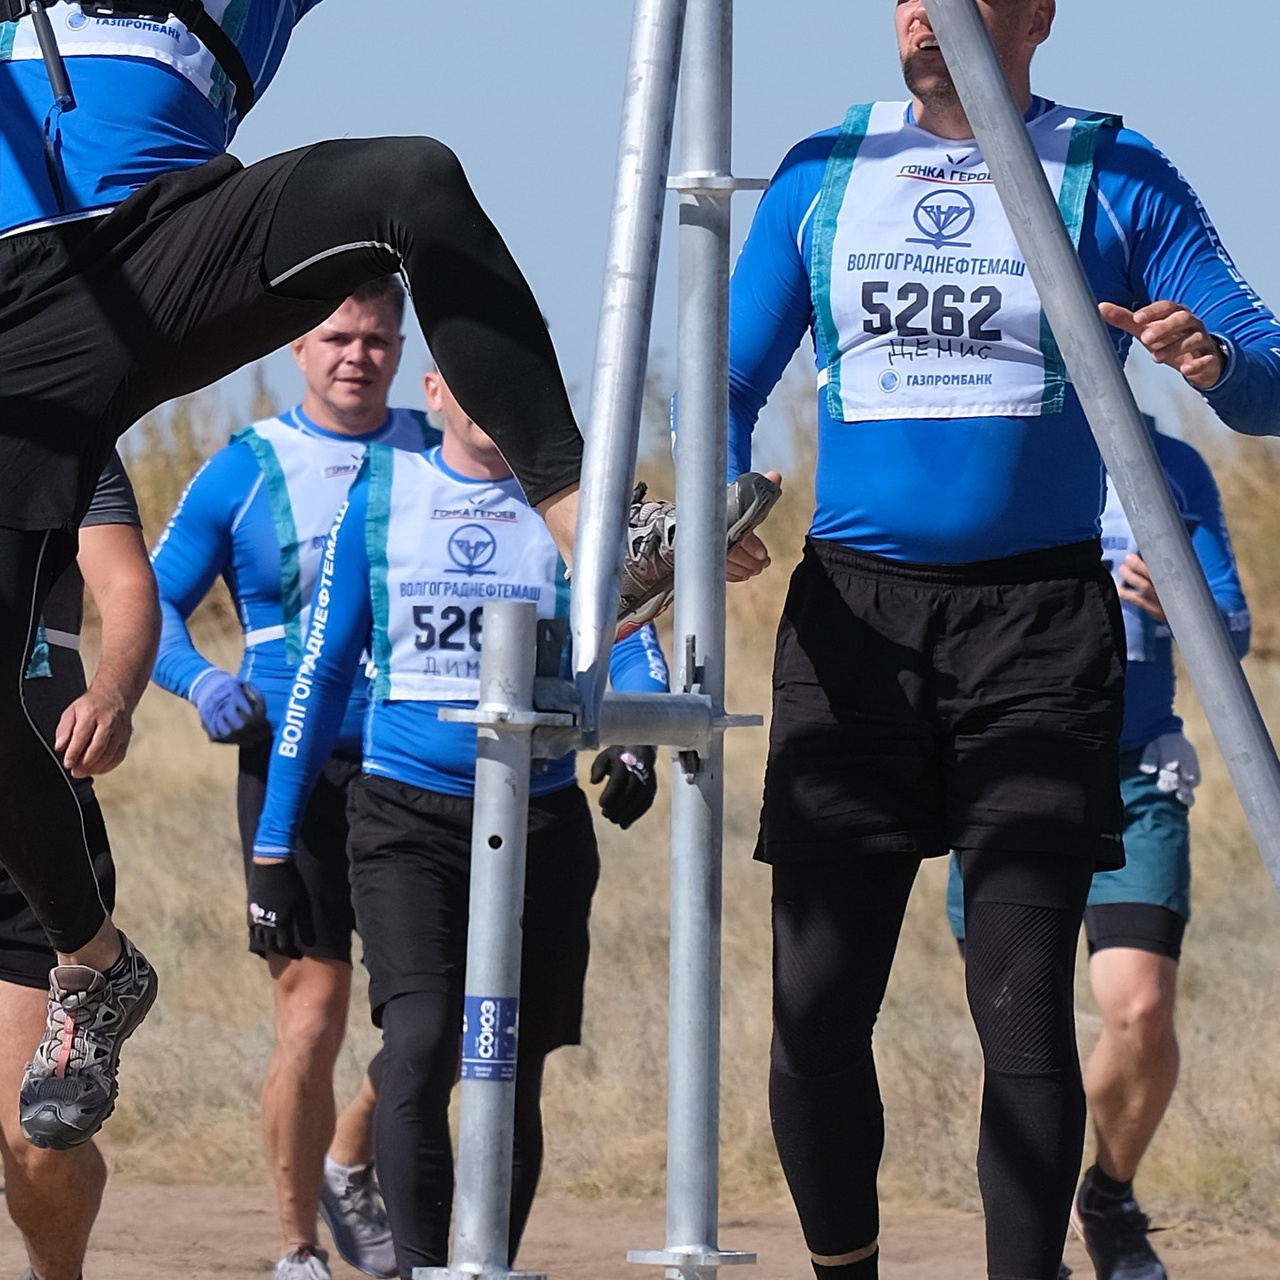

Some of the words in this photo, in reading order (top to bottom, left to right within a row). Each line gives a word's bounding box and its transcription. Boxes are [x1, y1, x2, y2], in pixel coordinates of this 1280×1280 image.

[95, 17, 182, 44] ГАЗПРОМБАНК
[899, 163, 946, 181] ГОНКА
[846, 252, 1026, 278] ВОЛГОГРАДНЕФТЕМАШ
[861, 281, 1003, 342] 5262
[887, 338, 993, 366] ДЕНИС
[906, 373, 993, 387] ГАЗПРОМБАНК
[399, 581, 542, 602] ВОЛГОГРАДНЕФТЕМАШ
[278, 500, 350, 760] ВОЛГОГРАДНЕФТЕМАШ
[422, 656, 482, 678] ДИМ
